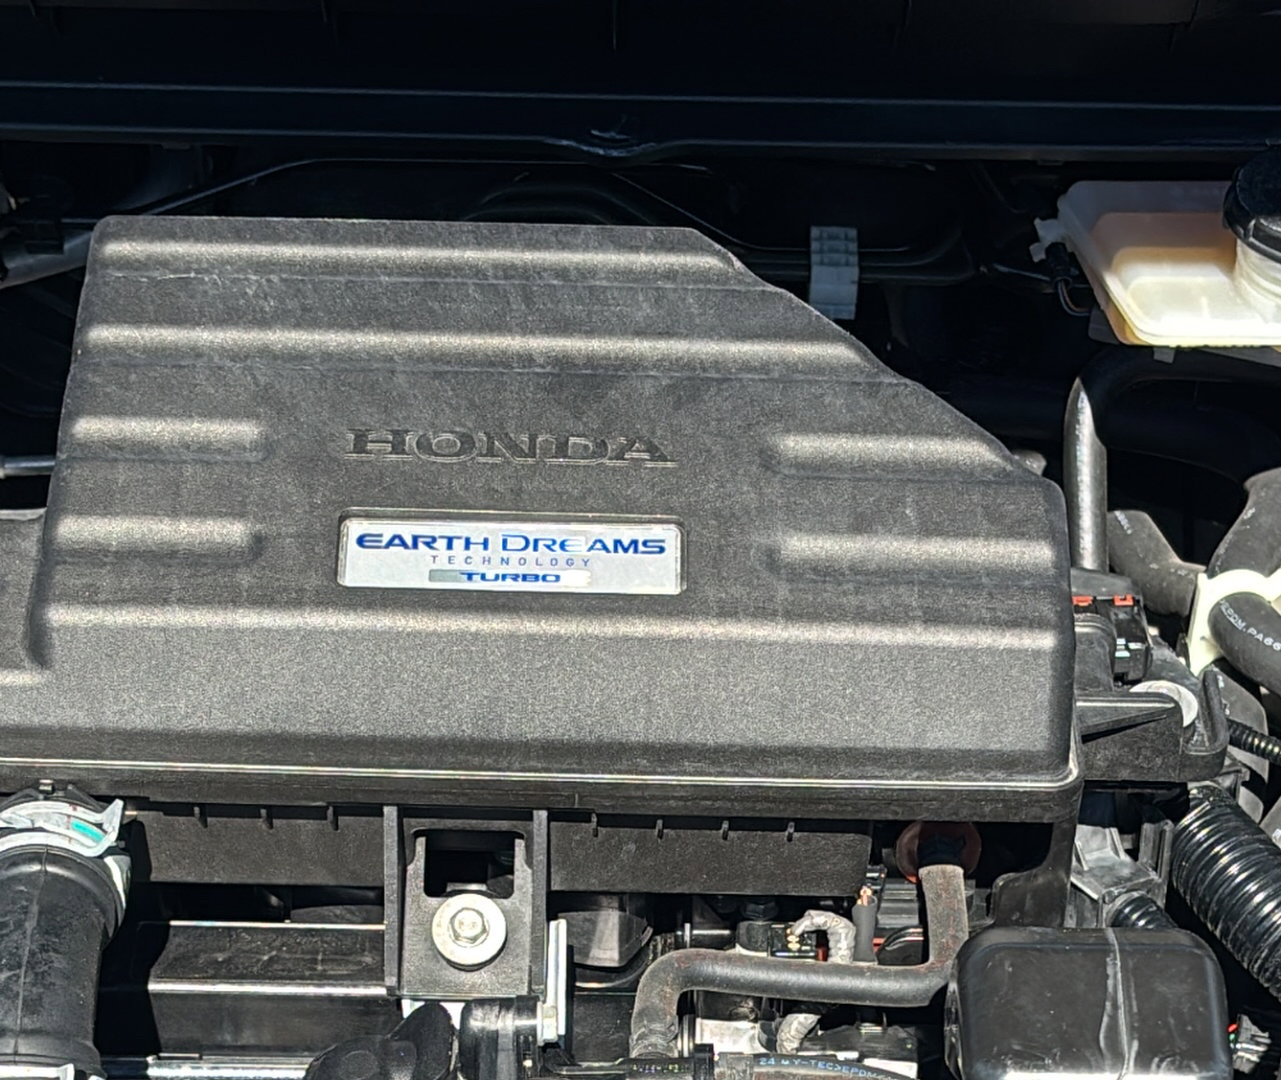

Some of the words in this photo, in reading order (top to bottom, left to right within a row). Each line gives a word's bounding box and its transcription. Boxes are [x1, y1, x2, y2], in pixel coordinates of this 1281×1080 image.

[344, 429, 679, 467] HONDA
[355, 533, 489, 552] EARTH
[501, 534, 667, 554] DREAMS
[430, 555, 591, 567] TECHNOLOGY
[461, 571, 562, 583] TURBO
